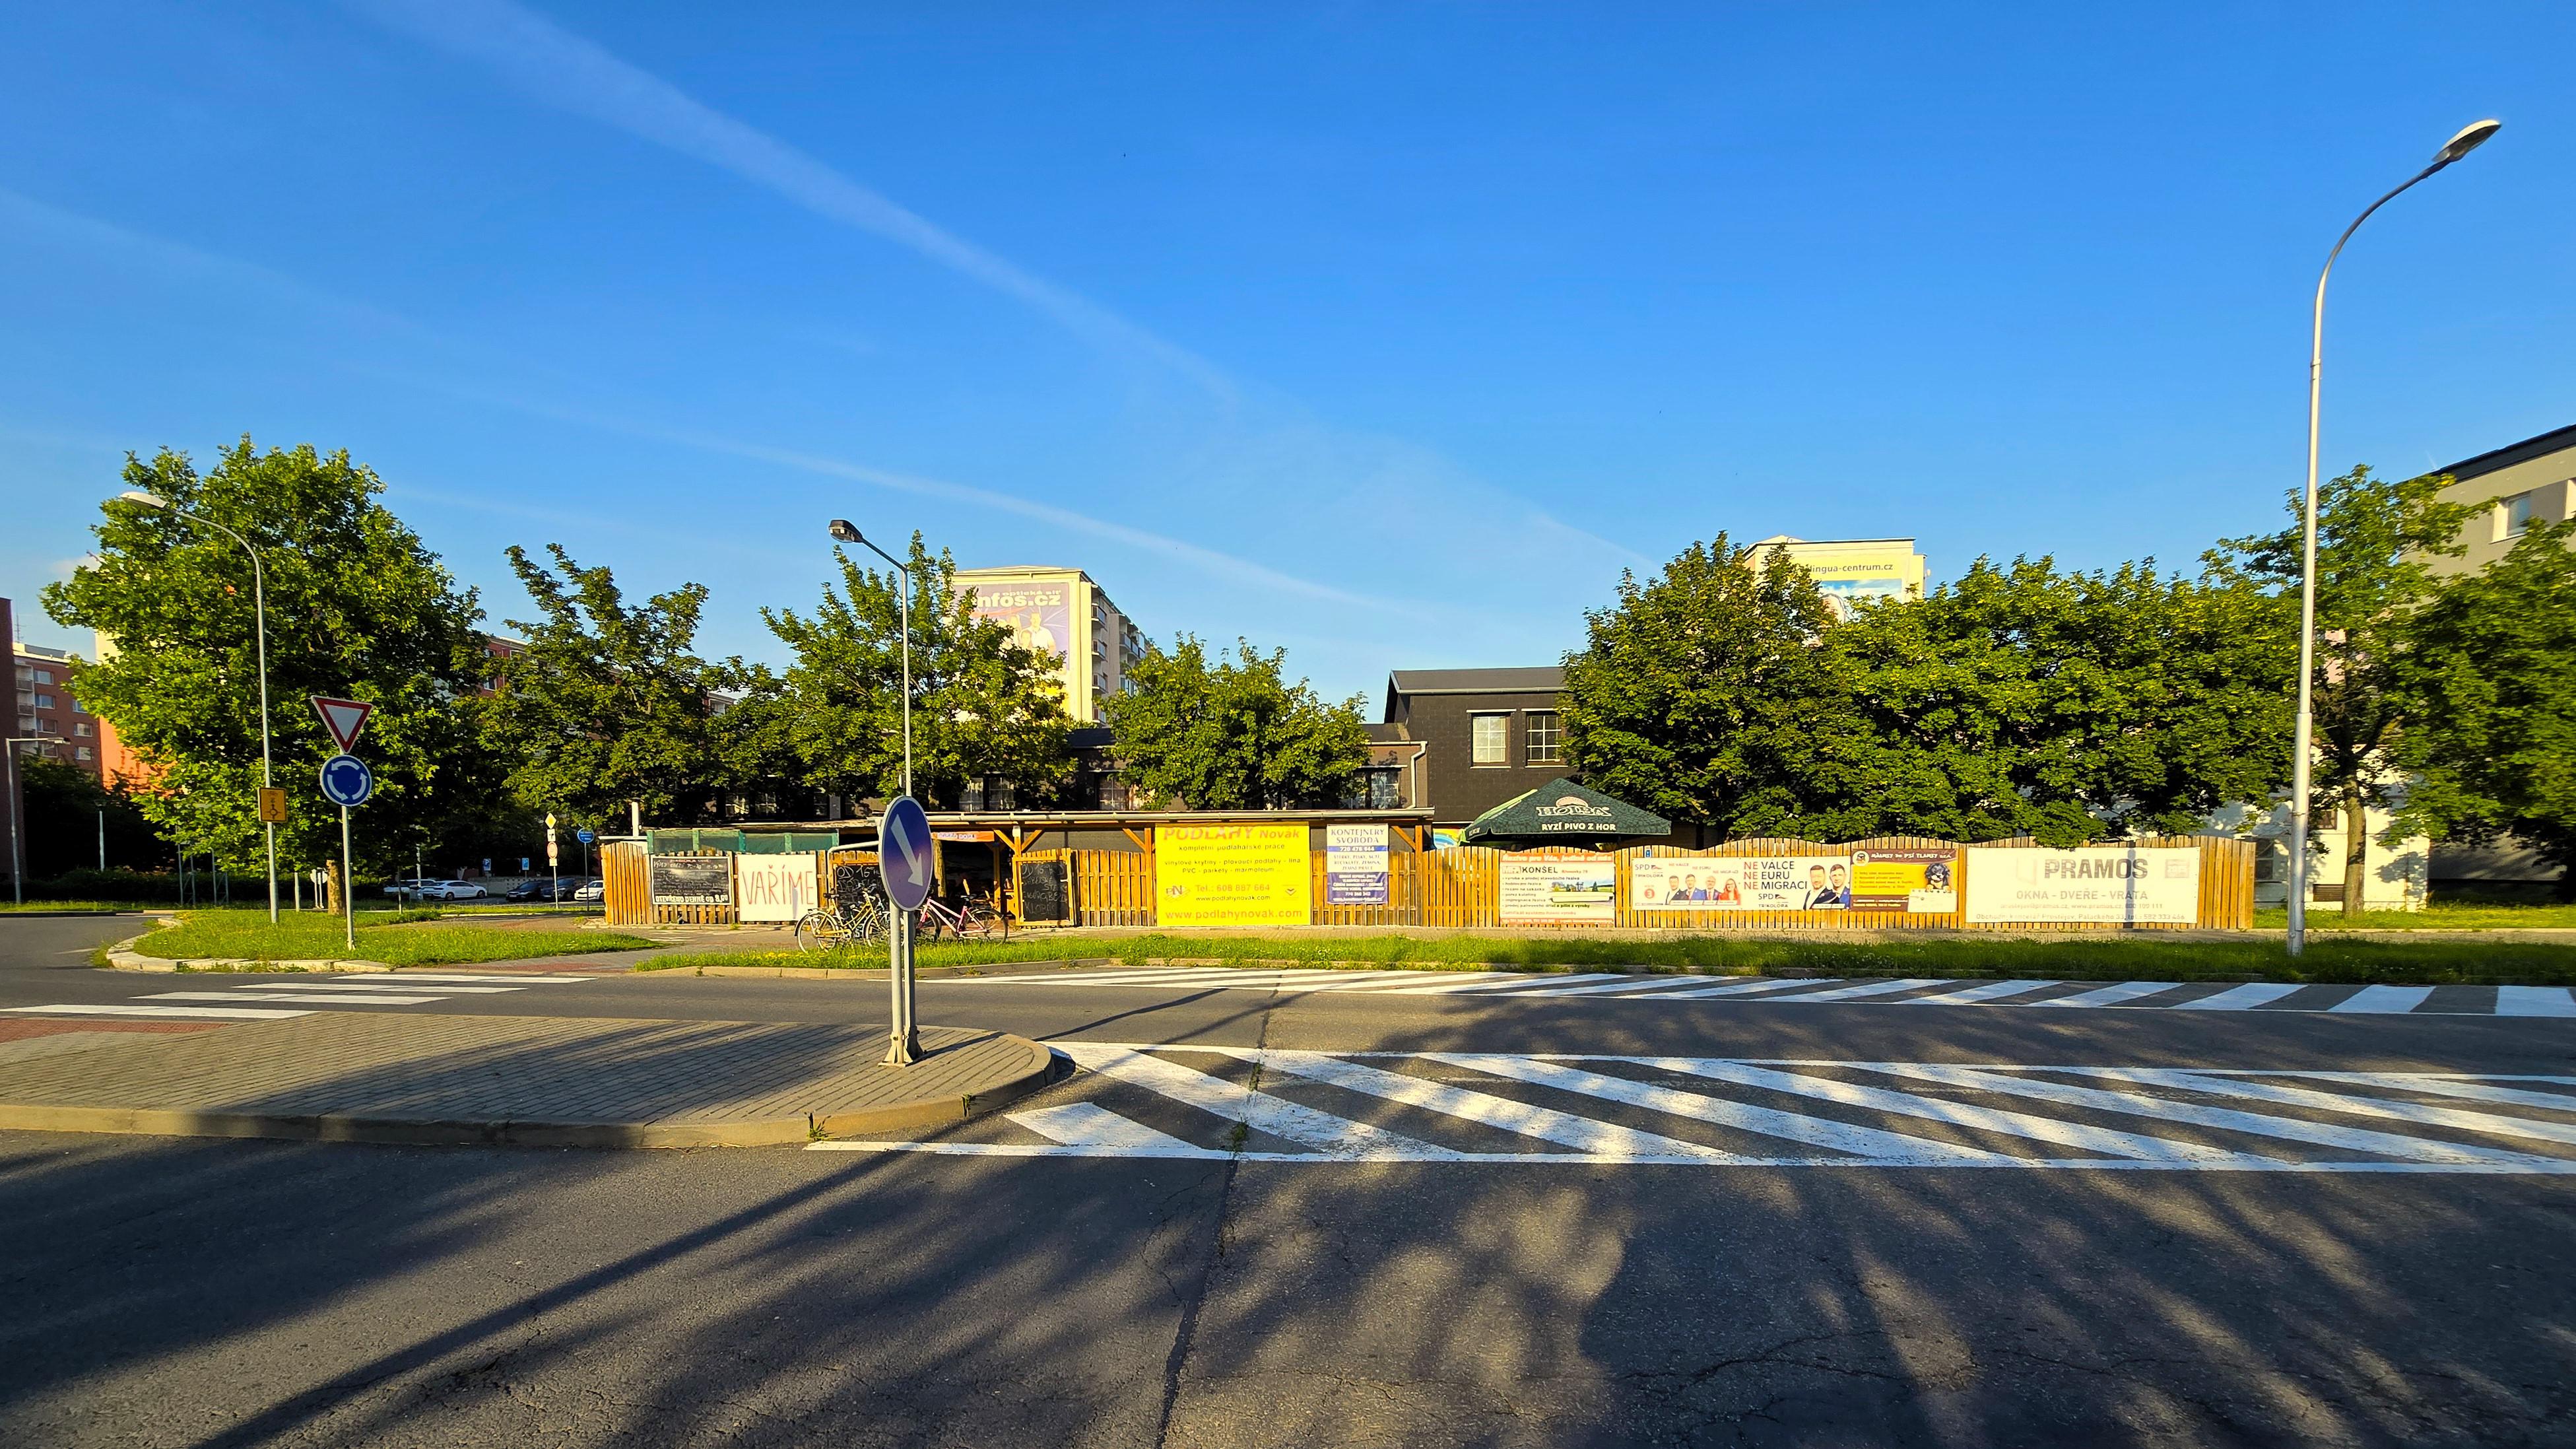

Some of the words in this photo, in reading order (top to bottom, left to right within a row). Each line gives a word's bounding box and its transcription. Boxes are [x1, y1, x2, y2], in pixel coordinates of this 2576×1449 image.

[973, 592, 1061, 607] nfos.cz
[1542, 822, 1562, 830] RYZÍ
[1164, 828, 1253, 840] PODLAHY
[1259, 829, 1300, 838] Novák
[1743, 861, 1758, 869] NE
[2044, 858, 2148, 879] PRAMOS
[837, 866, 854, 879] OD
[1743, 871, 1758, 879] NE
[1761, 871, 1790, 879] EURU
[741, 864, 814, 905] VAŘÍME
[1743, 881, 1758, 890] NE
[2016, 890, 2049, 900] OKNA
[2060, 888, 2099, 900] DVEŘE
[2109, 890, 2148, 900] VRATA
[1165, 909, 1302, 920] www.podlahynovak.com
